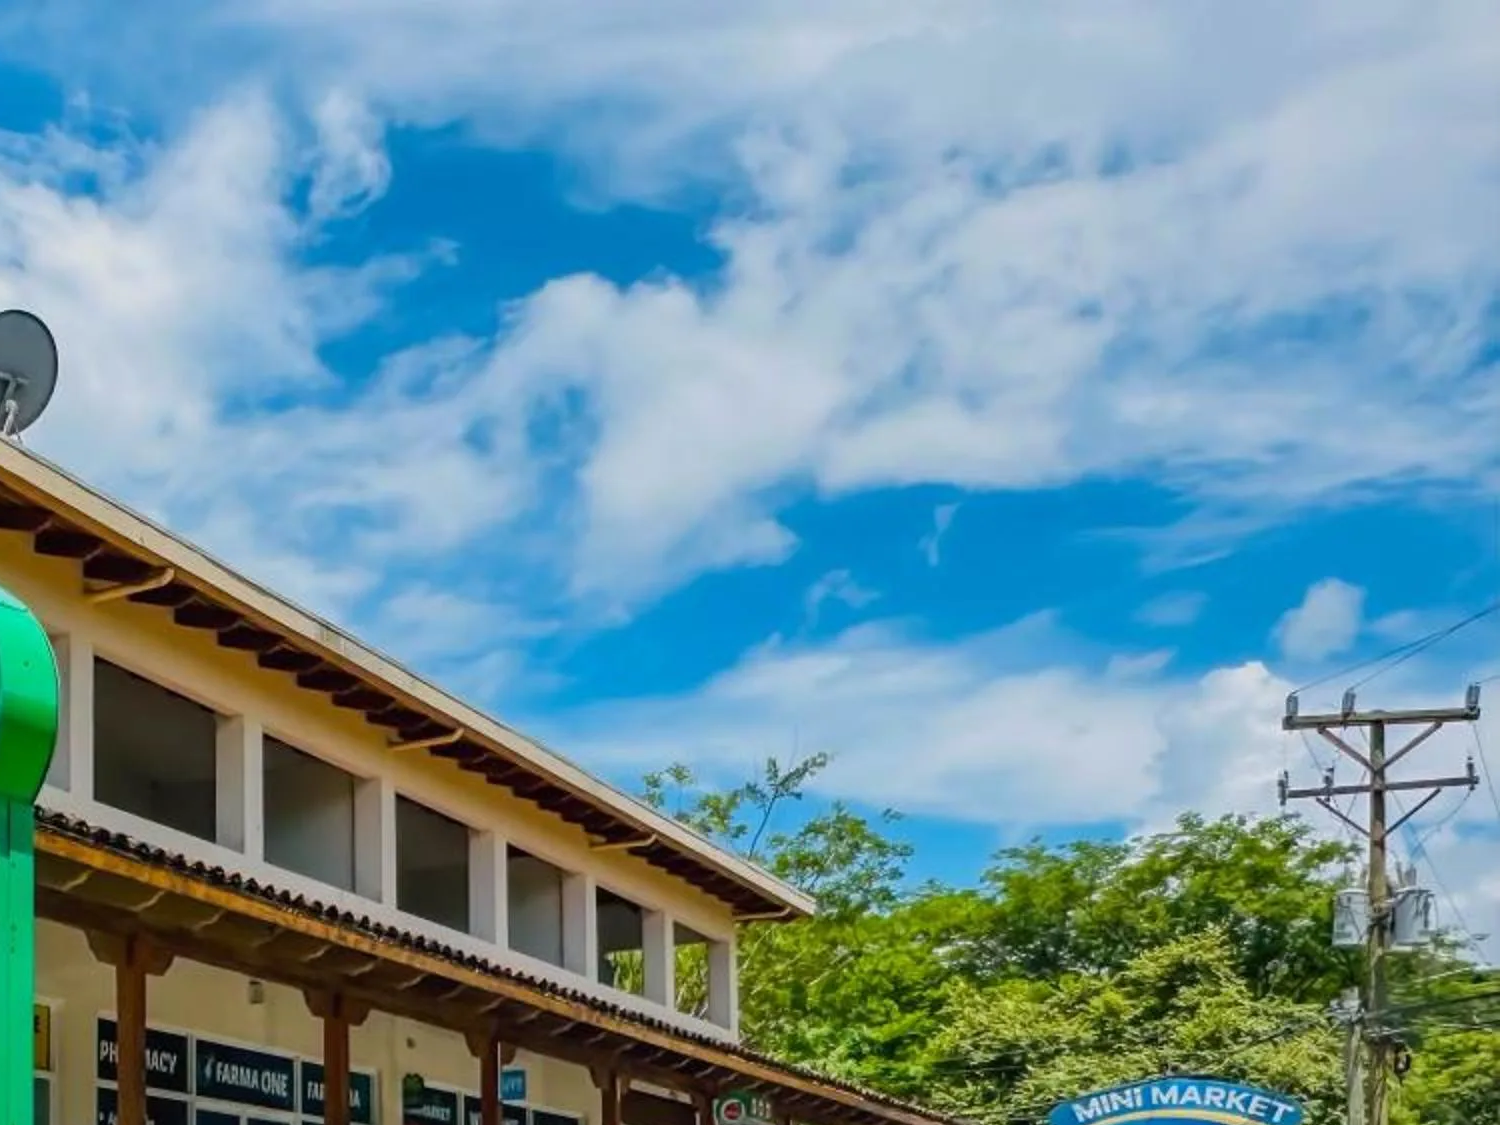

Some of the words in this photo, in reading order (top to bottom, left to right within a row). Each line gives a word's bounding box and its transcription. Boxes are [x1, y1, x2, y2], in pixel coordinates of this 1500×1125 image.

[215, 1061, 259, 1090] FARMA
[261, 1069, 289, 1098] ONE
[1151, 1084, 1295, 1123] MARKET
